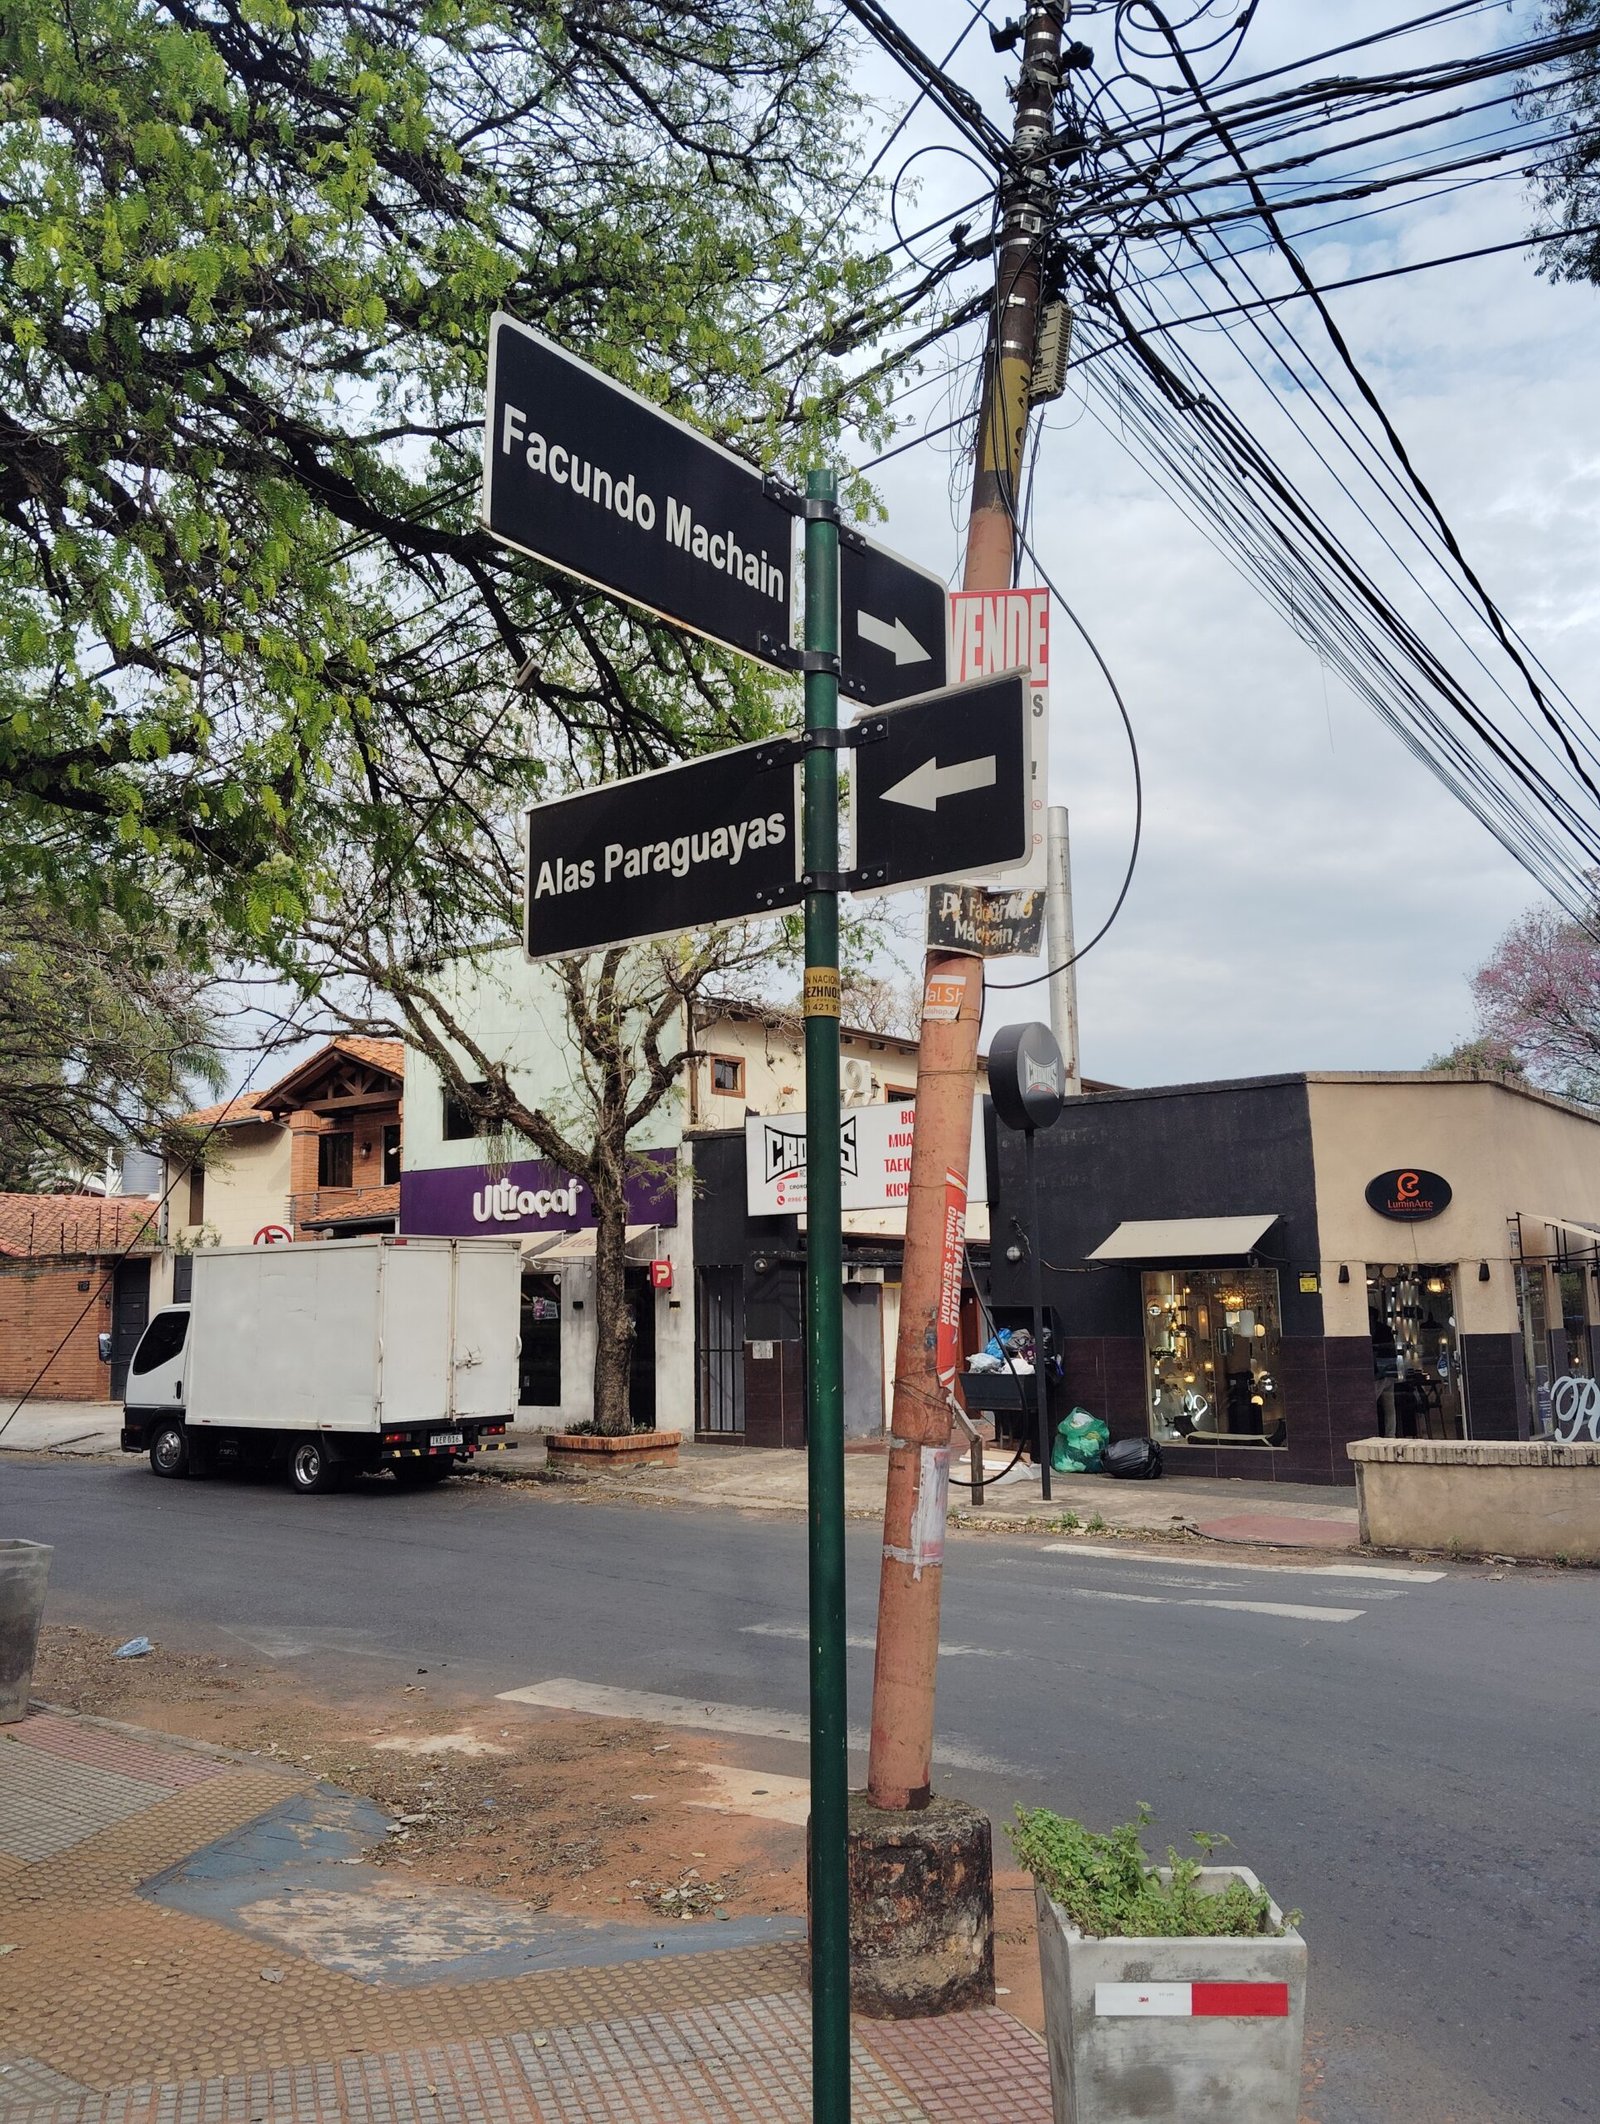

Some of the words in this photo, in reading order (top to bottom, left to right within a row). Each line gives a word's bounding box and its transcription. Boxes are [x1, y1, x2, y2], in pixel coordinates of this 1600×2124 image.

[502, 402, 656, 531] Facundo
[665, 496, 784, 603] Machain
[949, 594, 1048, 684] VENDE
[534, 857, 596, 900] Alas
[604, 812, 787, 878] Paraguayas
[888, 1133, 913, 1148] MUA
[944, 1205, 956, 1251] CHASE
[1387, 1199, 1434, 1209] LuminArte
[940, 1260, 953, 1325] SENADOR
[950, 1210, 966, 1328] NATALICIO
